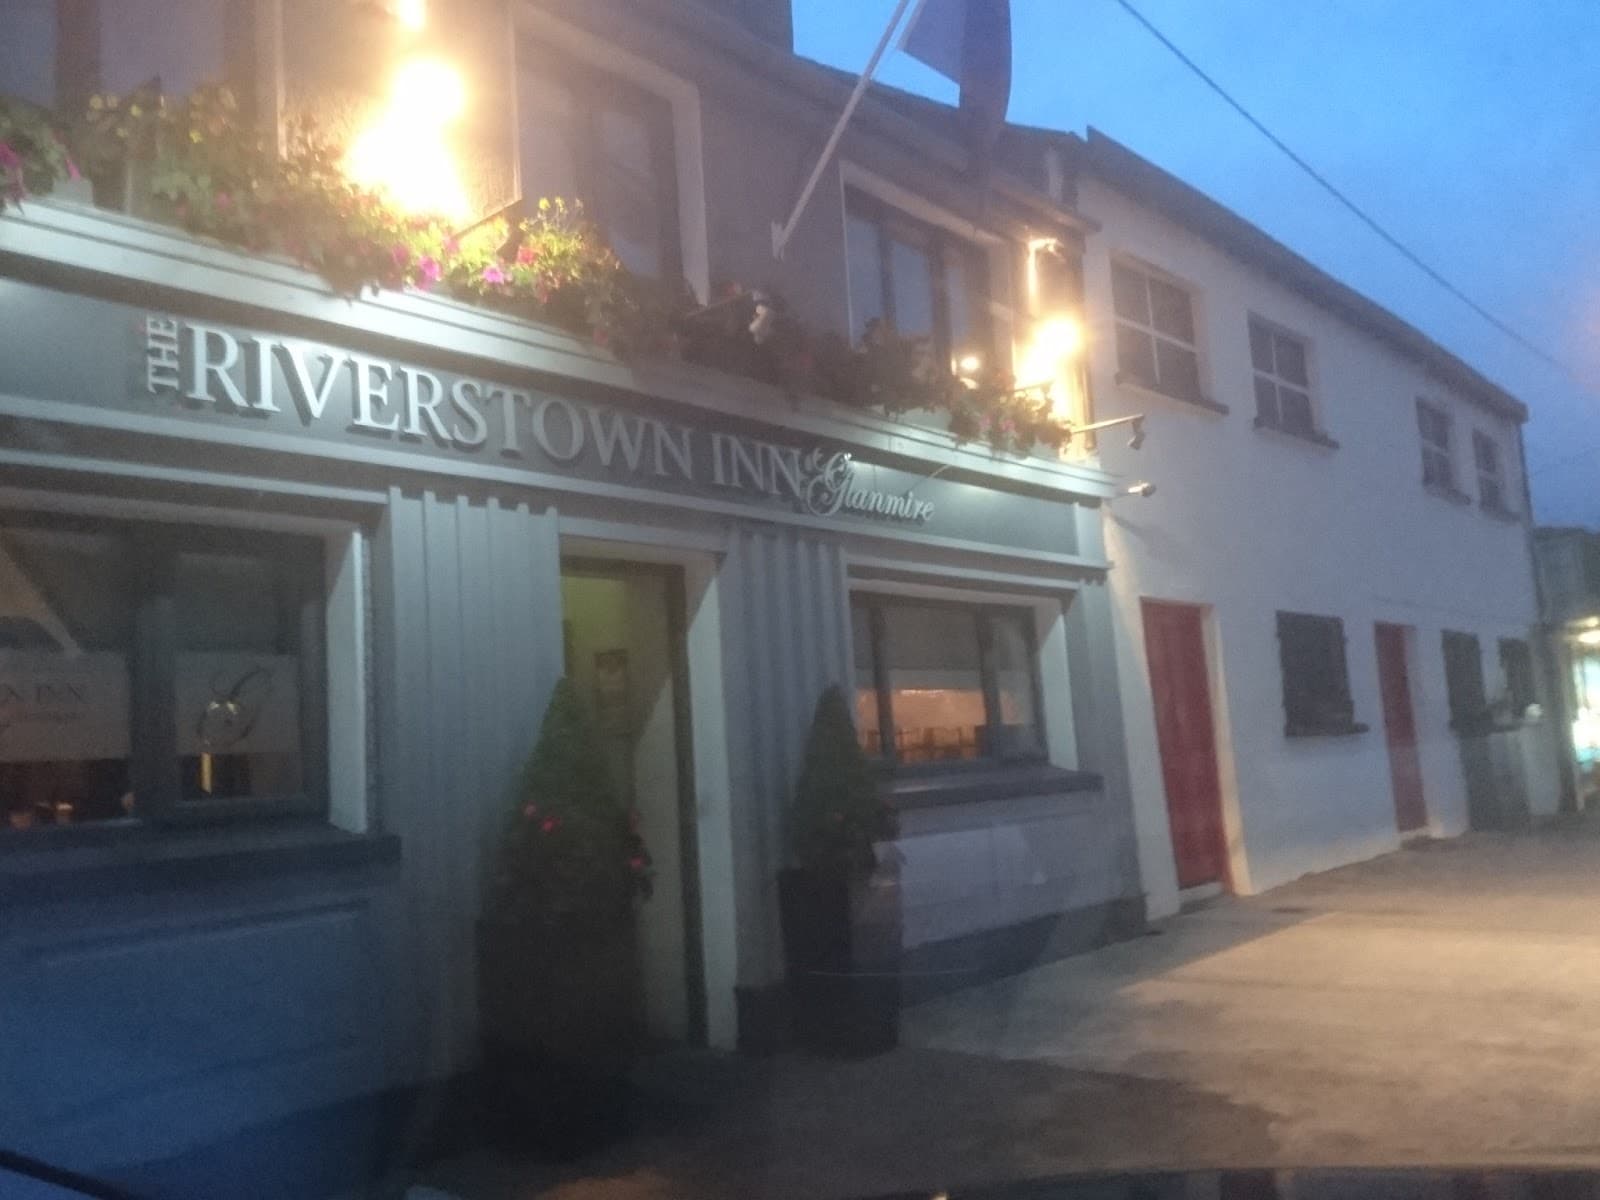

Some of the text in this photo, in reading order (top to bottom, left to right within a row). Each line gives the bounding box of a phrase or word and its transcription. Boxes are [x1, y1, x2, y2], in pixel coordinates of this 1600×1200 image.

[146, 314, 180, 394] THE
[186, 321, 803, 499] RIVERSTOWN INN
[804, 450, 935, 521] Glanmire
